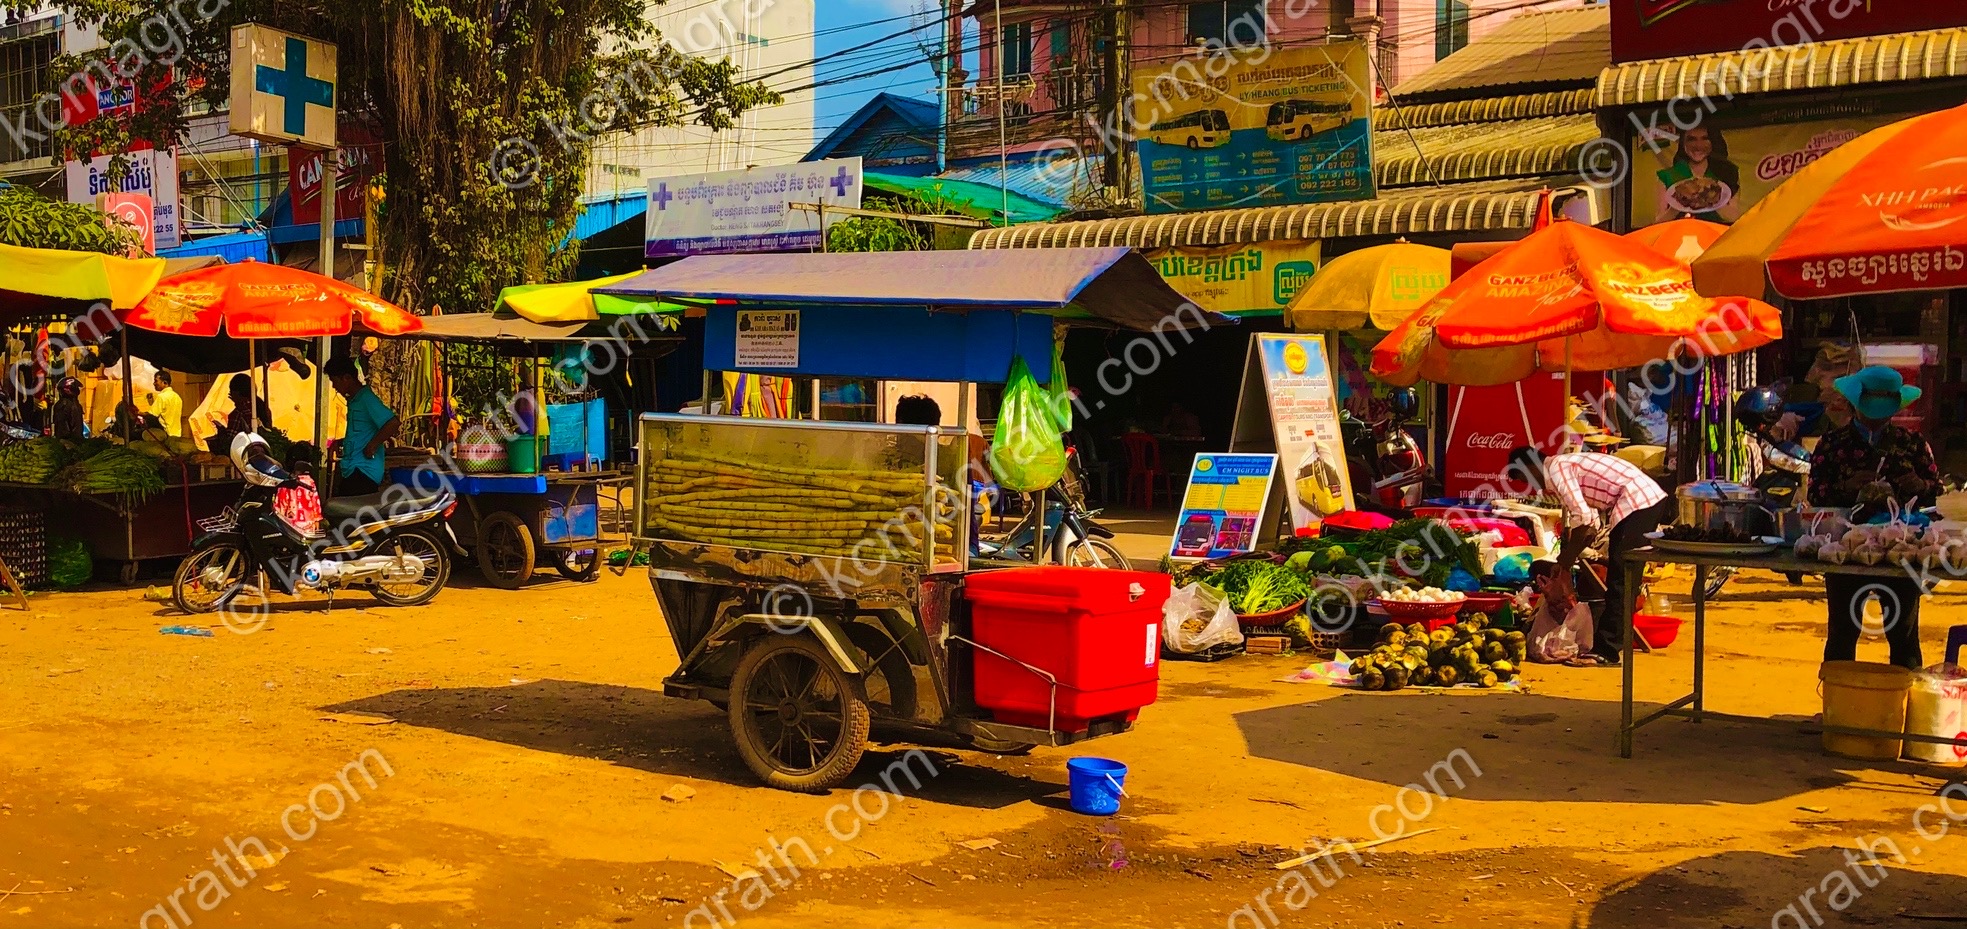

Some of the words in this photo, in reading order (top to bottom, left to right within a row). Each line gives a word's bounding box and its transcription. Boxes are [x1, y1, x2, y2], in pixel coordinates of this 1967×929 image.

[1251, 89, 1280, 98] HEANG
[1282, 87, 1298, 95] BUS
[1301, 82, 1346, 93] TICKETING
[1487, 262, 1580, 286] GANZBERG
[1467, 432, 1515, 450] Coca-Cola
